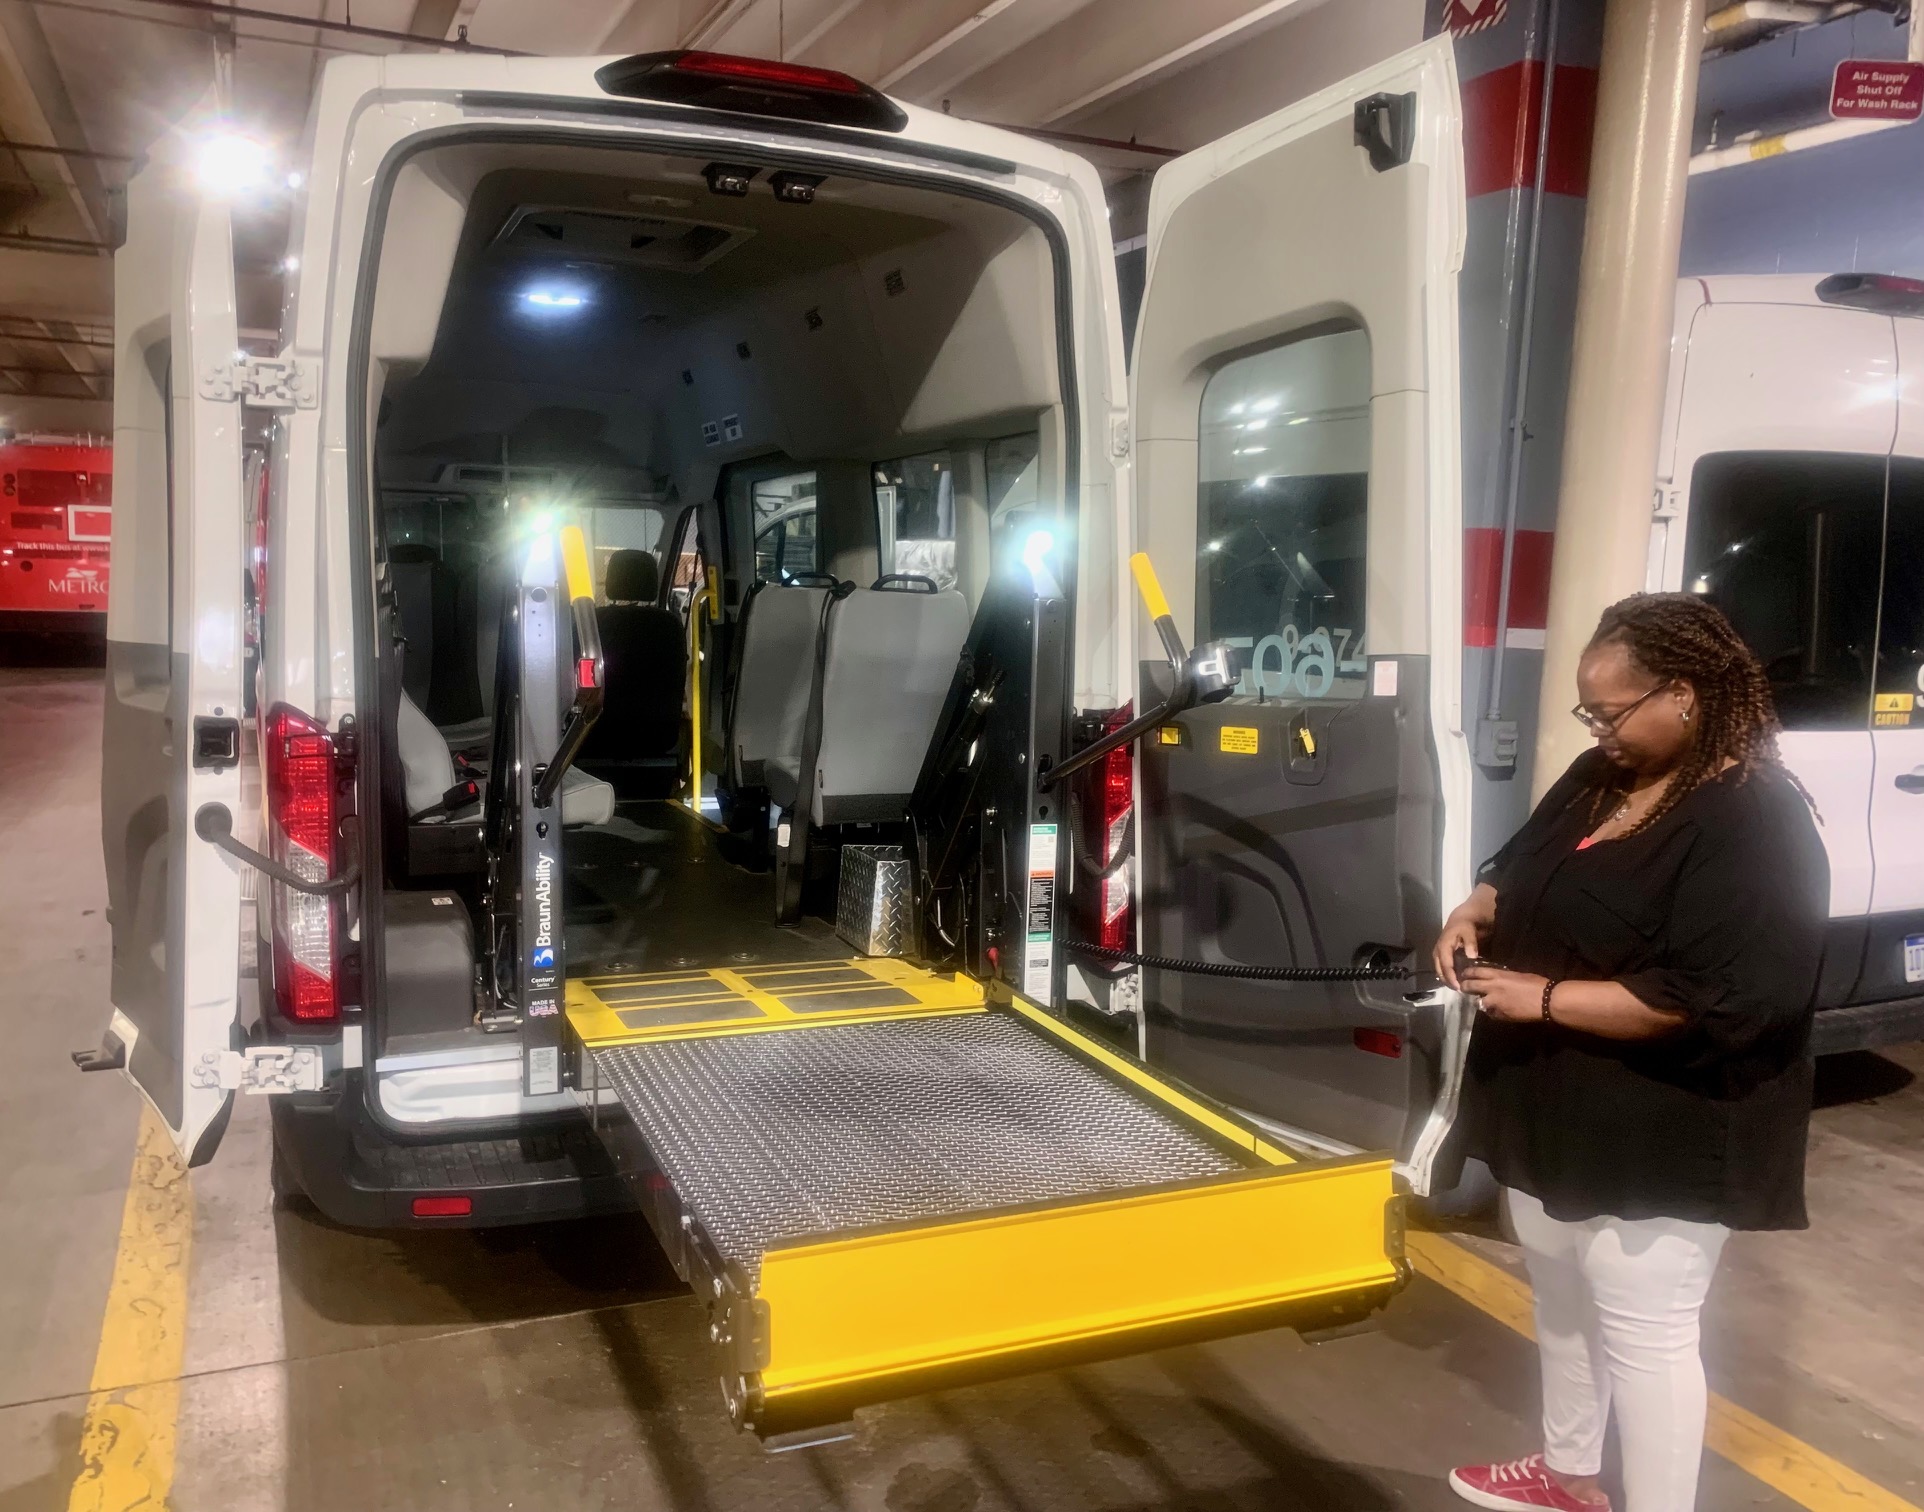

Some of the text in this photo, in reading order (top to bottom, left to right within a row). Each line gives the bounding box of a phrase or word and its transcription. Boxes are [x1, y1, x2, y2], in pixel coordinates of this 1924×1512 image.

[1853, 72, 1909, 83] Air Supply
[1857, 85, 1903, 95] Shut Off
[1836, 98, 1918, 109] For Wash Rack
[16, 542, 38, 550] Track
[39, 542, 54, 551] this
[56, 543, 71, 551] bus
[536, 852, 554, 947] BraunAbility
